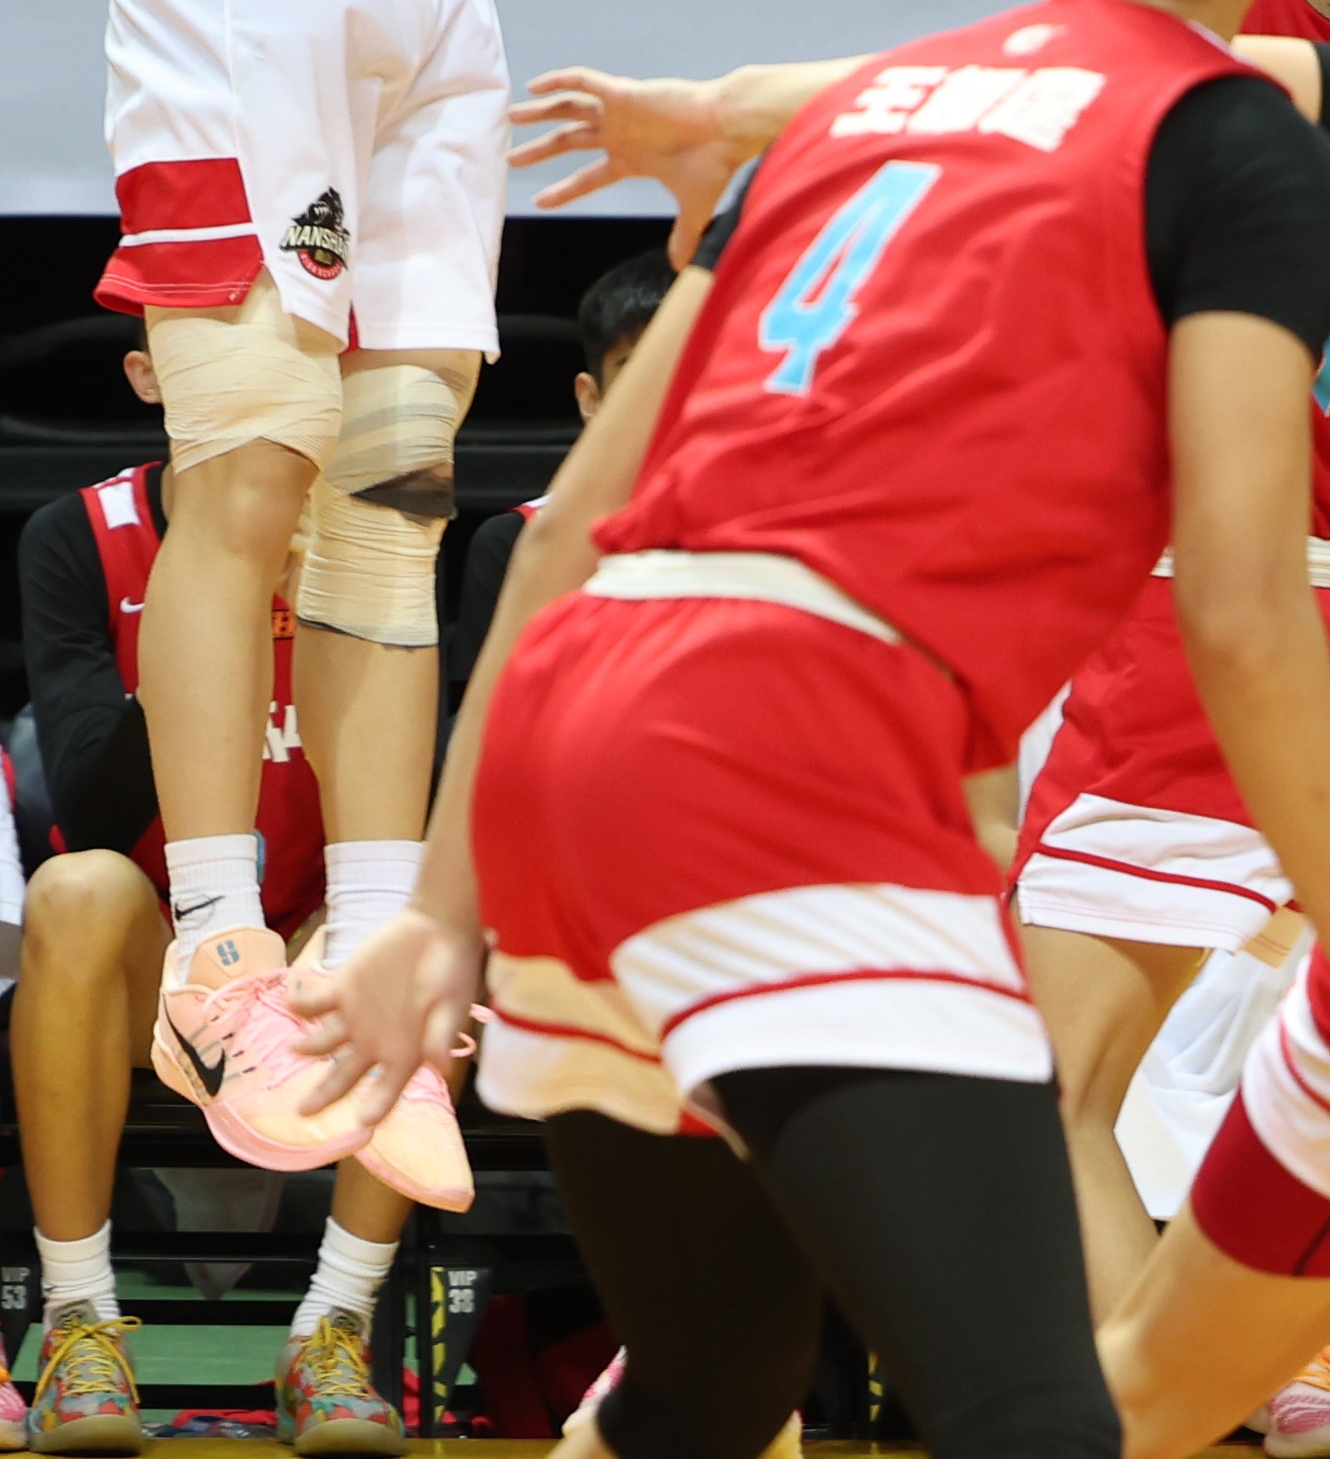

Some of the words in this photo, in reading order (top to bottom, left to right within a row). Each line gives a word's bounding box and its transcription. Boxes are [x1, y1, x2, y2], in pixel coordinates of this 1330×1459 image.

[758, 159, 941, 397] 4
[1, 1266, 30, 1282] VIP
[448, 1270, 478, 1286] VIP
[0, 1285, 27, 1310] 53
